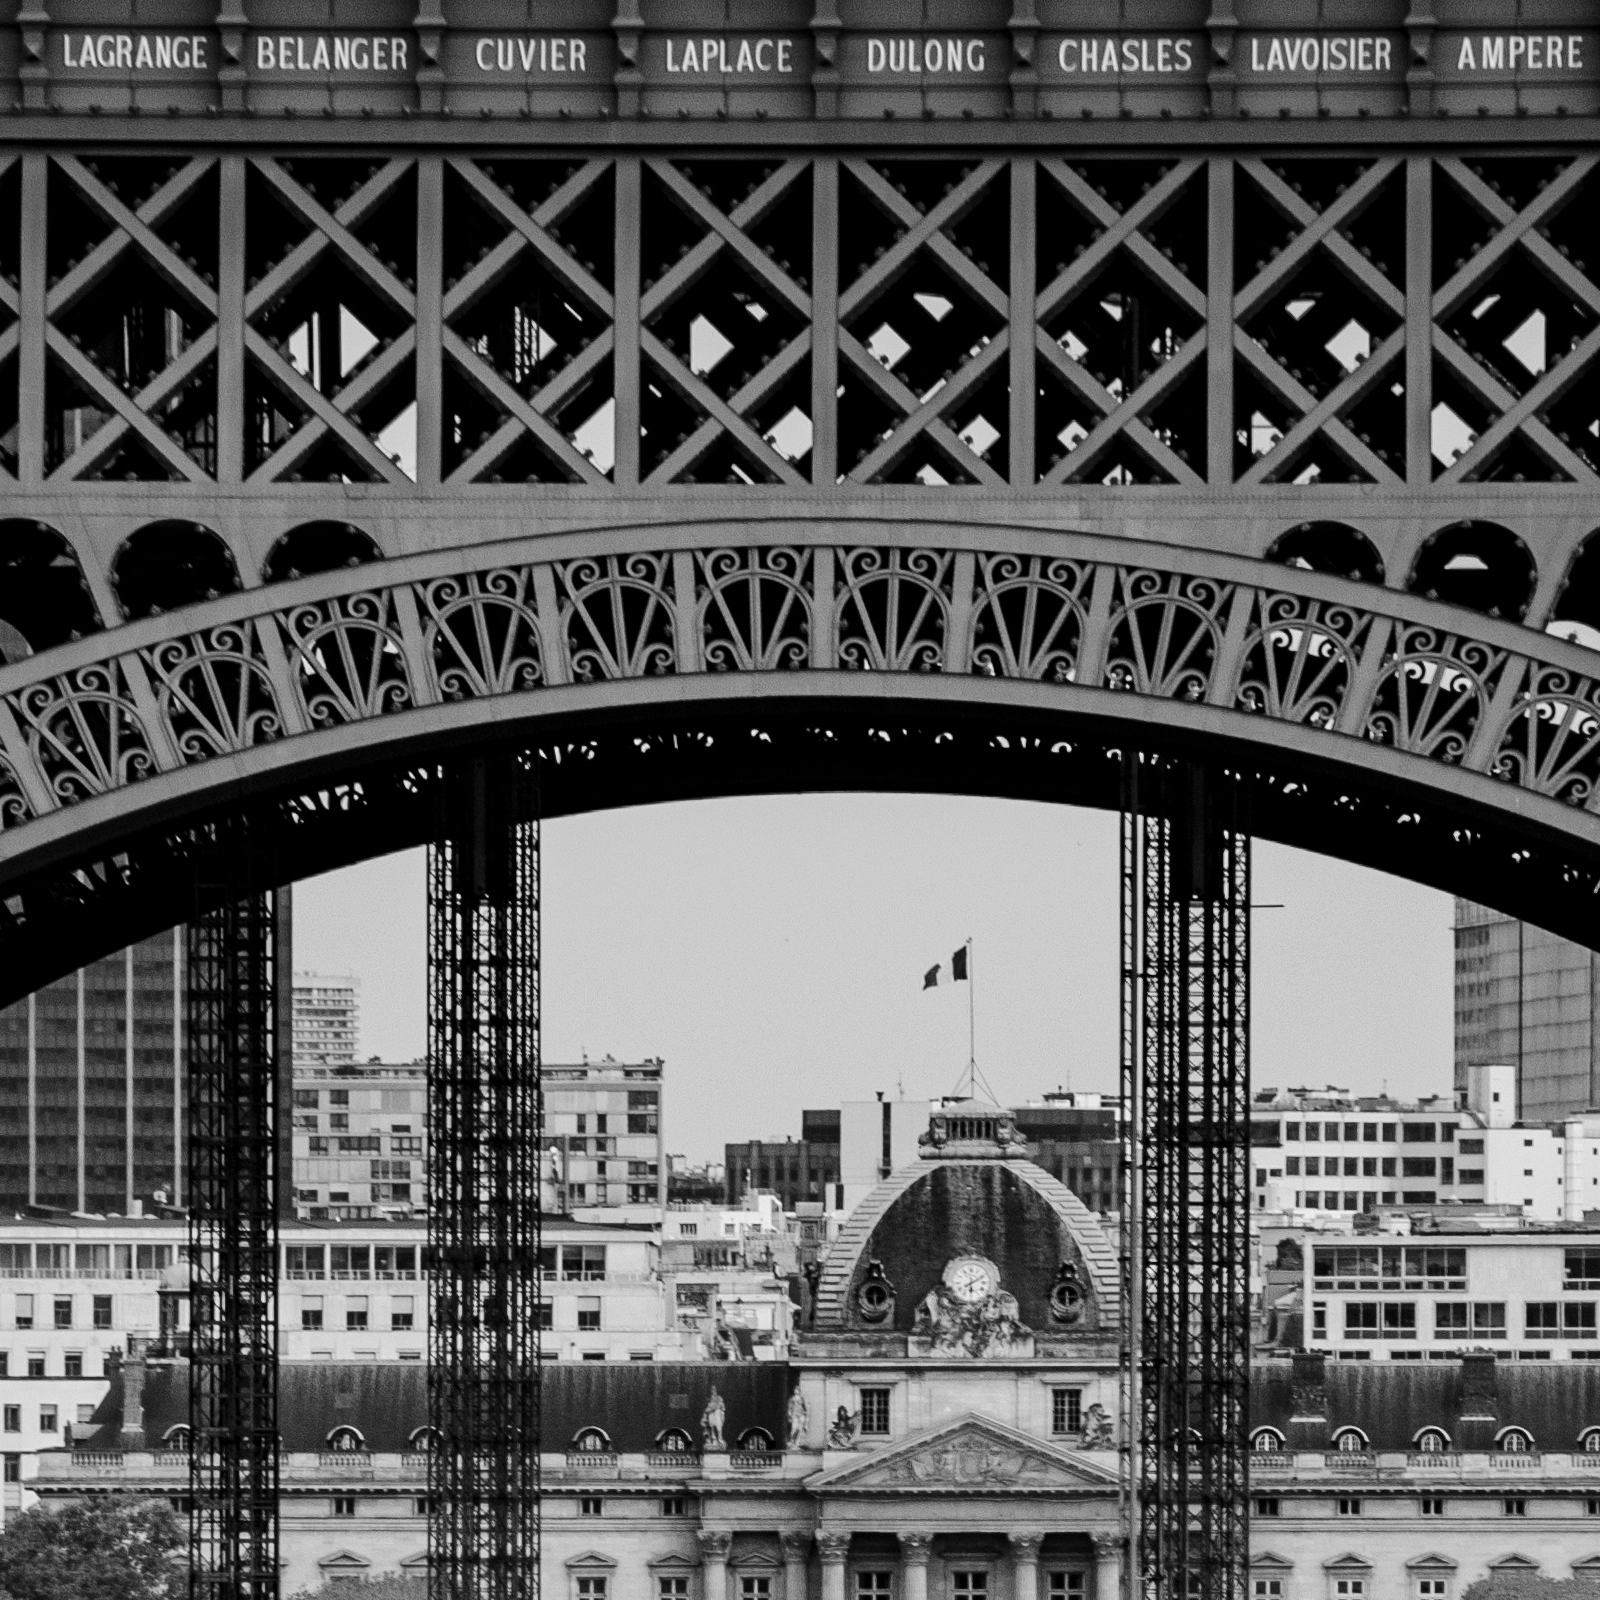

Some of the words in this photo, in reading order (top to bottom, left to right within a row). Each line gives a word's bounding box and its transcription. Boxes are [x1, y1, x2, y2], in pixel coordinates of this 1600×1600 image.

[64, 34, 207, 69] LAGRANGE
[257, 36, 407, 70] BELANGER
[476, 38, 586, 72] CUVIER
[666, 39, 792, 73] LAPLACE
[868, 39, 985, 73] DULONG
[1058, 39, 1192, 73] CHASLES
[1252, 38, 1391, 71] LAVOISIER
[1458, 36, 1583, 69] AMPERE
